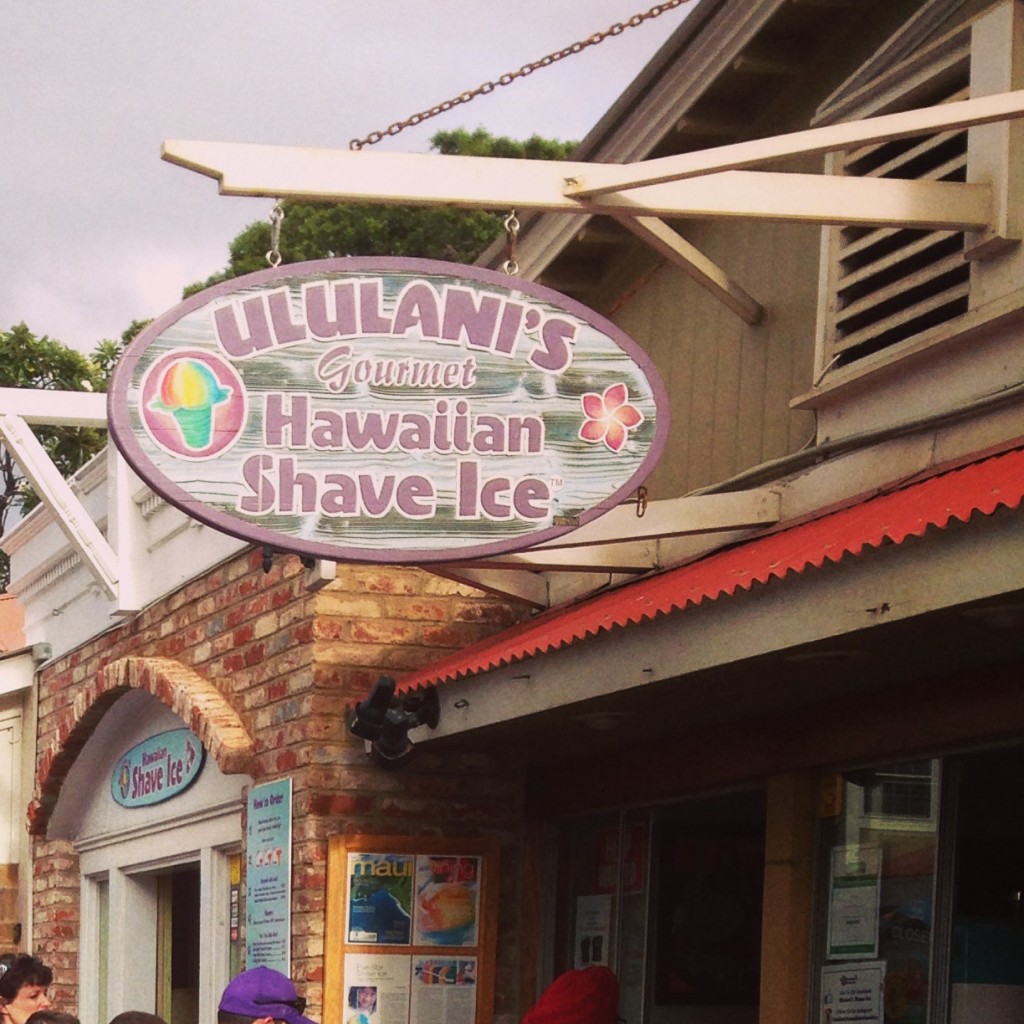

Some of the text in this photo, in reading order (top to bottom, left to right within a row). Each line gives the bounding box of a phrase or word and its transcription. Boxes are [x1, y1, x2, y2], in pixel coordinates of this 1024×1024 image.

[212, 279, 578, 374] ULULANI'S
[316, 345, 476, 392] Gourmet
[263, 393, 545, 455] Hawaiian
[239, 454, 437, 518] Shave
[457, 460, 553, 521] Ice
[132, 753, 183, 800] Shave Ice
[890, 926, 931, 943] CLOSE
